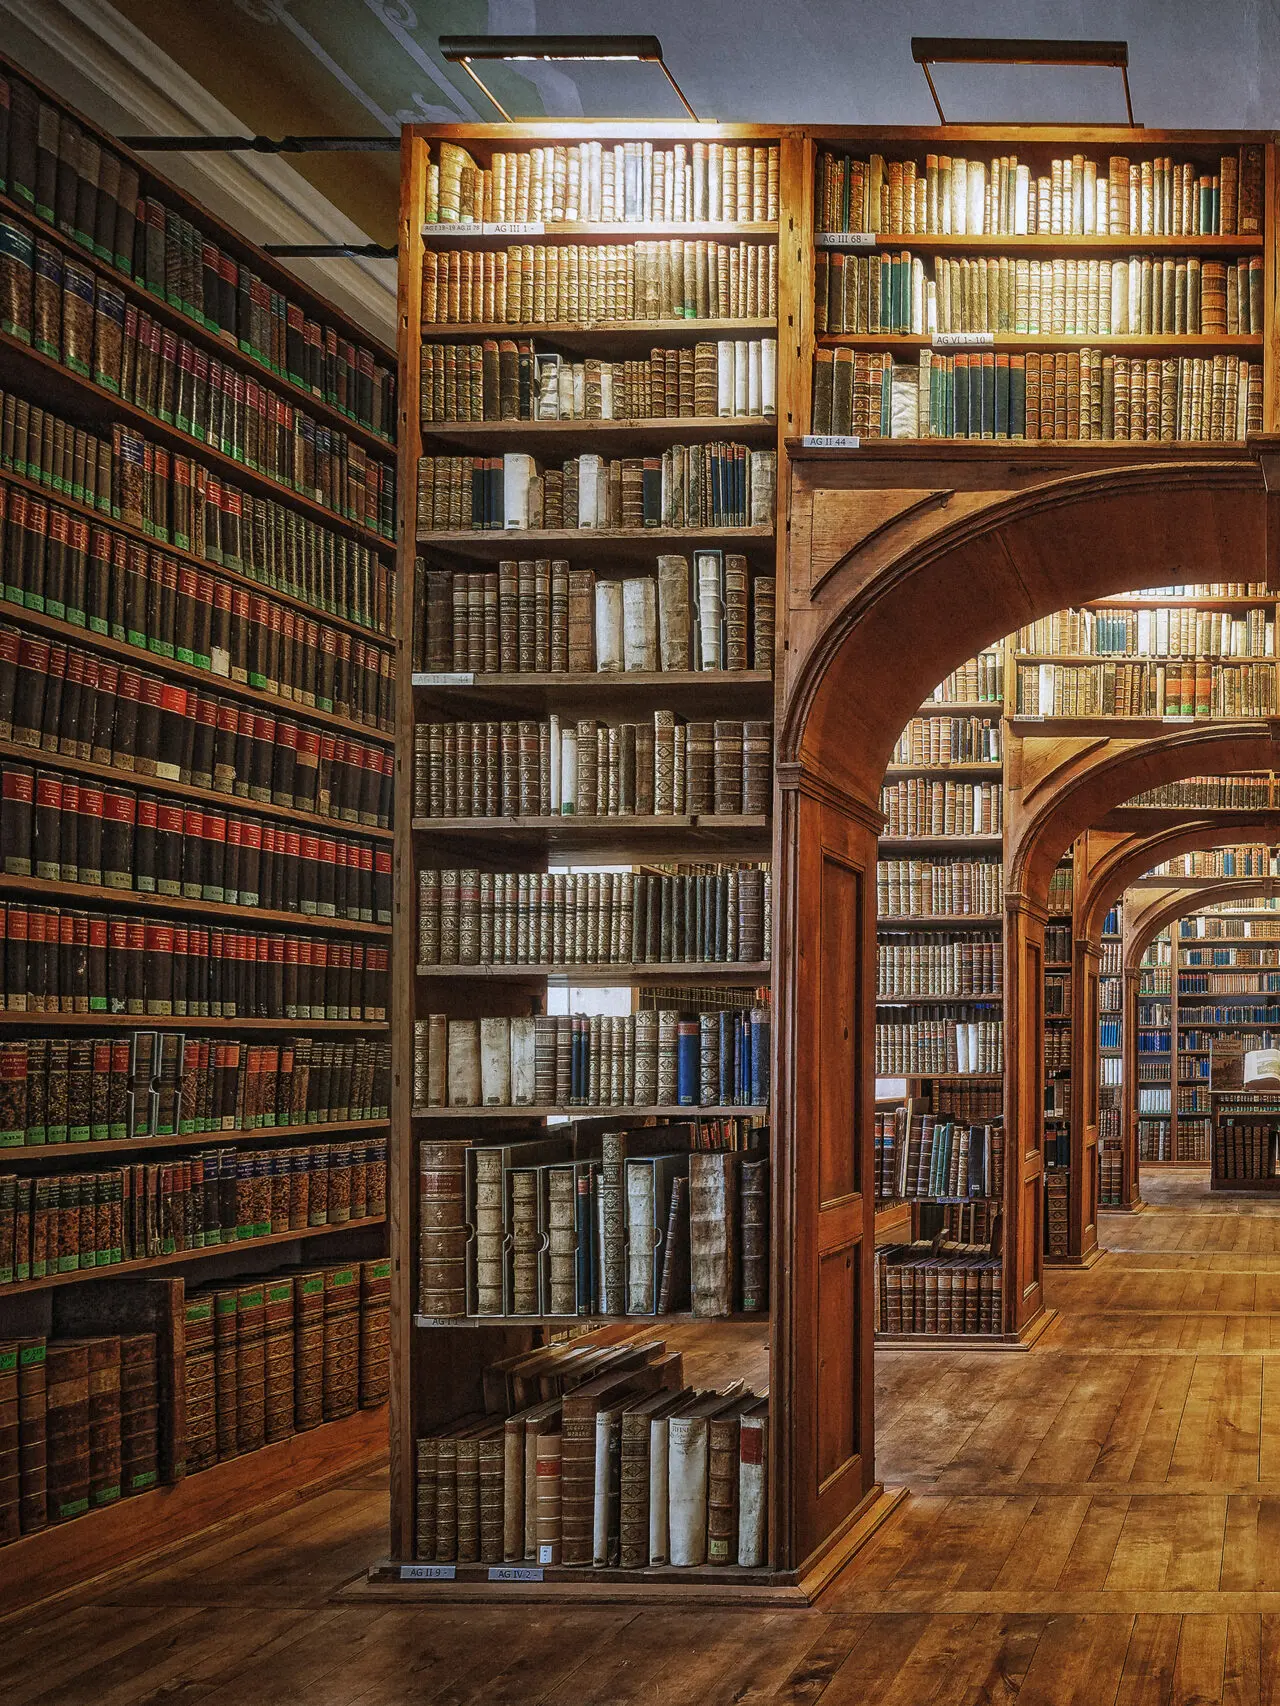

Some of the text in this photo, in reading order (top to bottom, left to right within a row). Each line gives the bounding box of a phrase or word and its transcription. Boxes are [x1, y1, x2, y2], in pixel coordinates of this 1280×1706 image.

[494, 224, 507, 233] AG
[509, 224, 521, 233] III
[523, 224, 528, 233] 1
[823, 234, 836, 244] AG
[838, 234, 849, 244] III
[850, 234, 862, 244] 68
[936, 336, 949, 345] AG
[951, 336, 961, 345] VI
[975, 336, 986, 345] 10
[810, 438, 823, 446] AG
[825, 438, 833, 446] II
[834, 438, 847, 446] 44
[410, 1568, 424, 1577] AG
[425, 1568, 434, 1577] II
[435, 1568, 441, 1577] 9
[498, 1570, 511, 1579] AG
[513, 1570, 524, 1579] IV
[525, 1570, 531, 1579] 2
